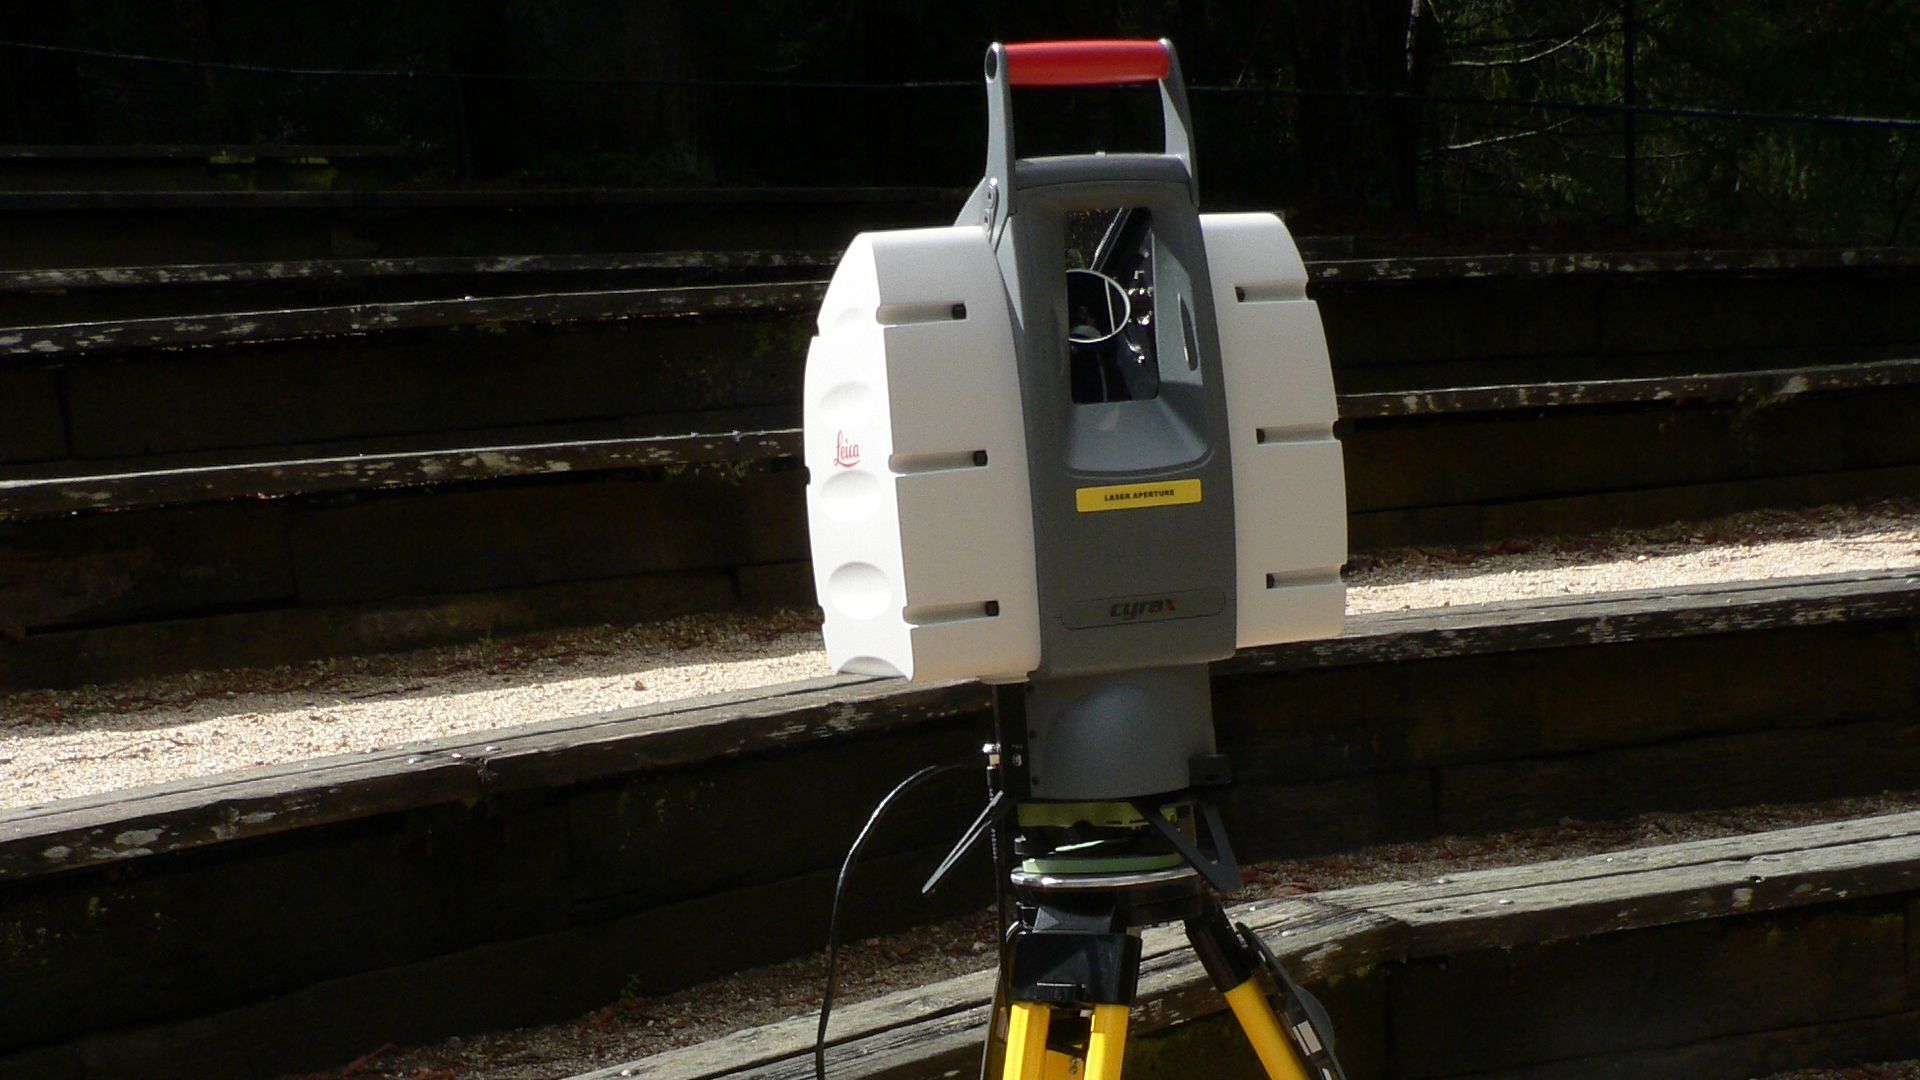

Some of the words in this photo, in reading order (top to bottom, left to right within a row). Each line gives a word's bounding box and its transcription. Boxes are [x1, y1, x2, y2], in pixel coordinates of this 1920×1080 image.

[833, 429, 862, 469] Leica
[1104, 492, 1131, 502] LASER
[1133, 489, 1175, 501] APERTURE
[1109, 597, 1177, 620] cyrax
